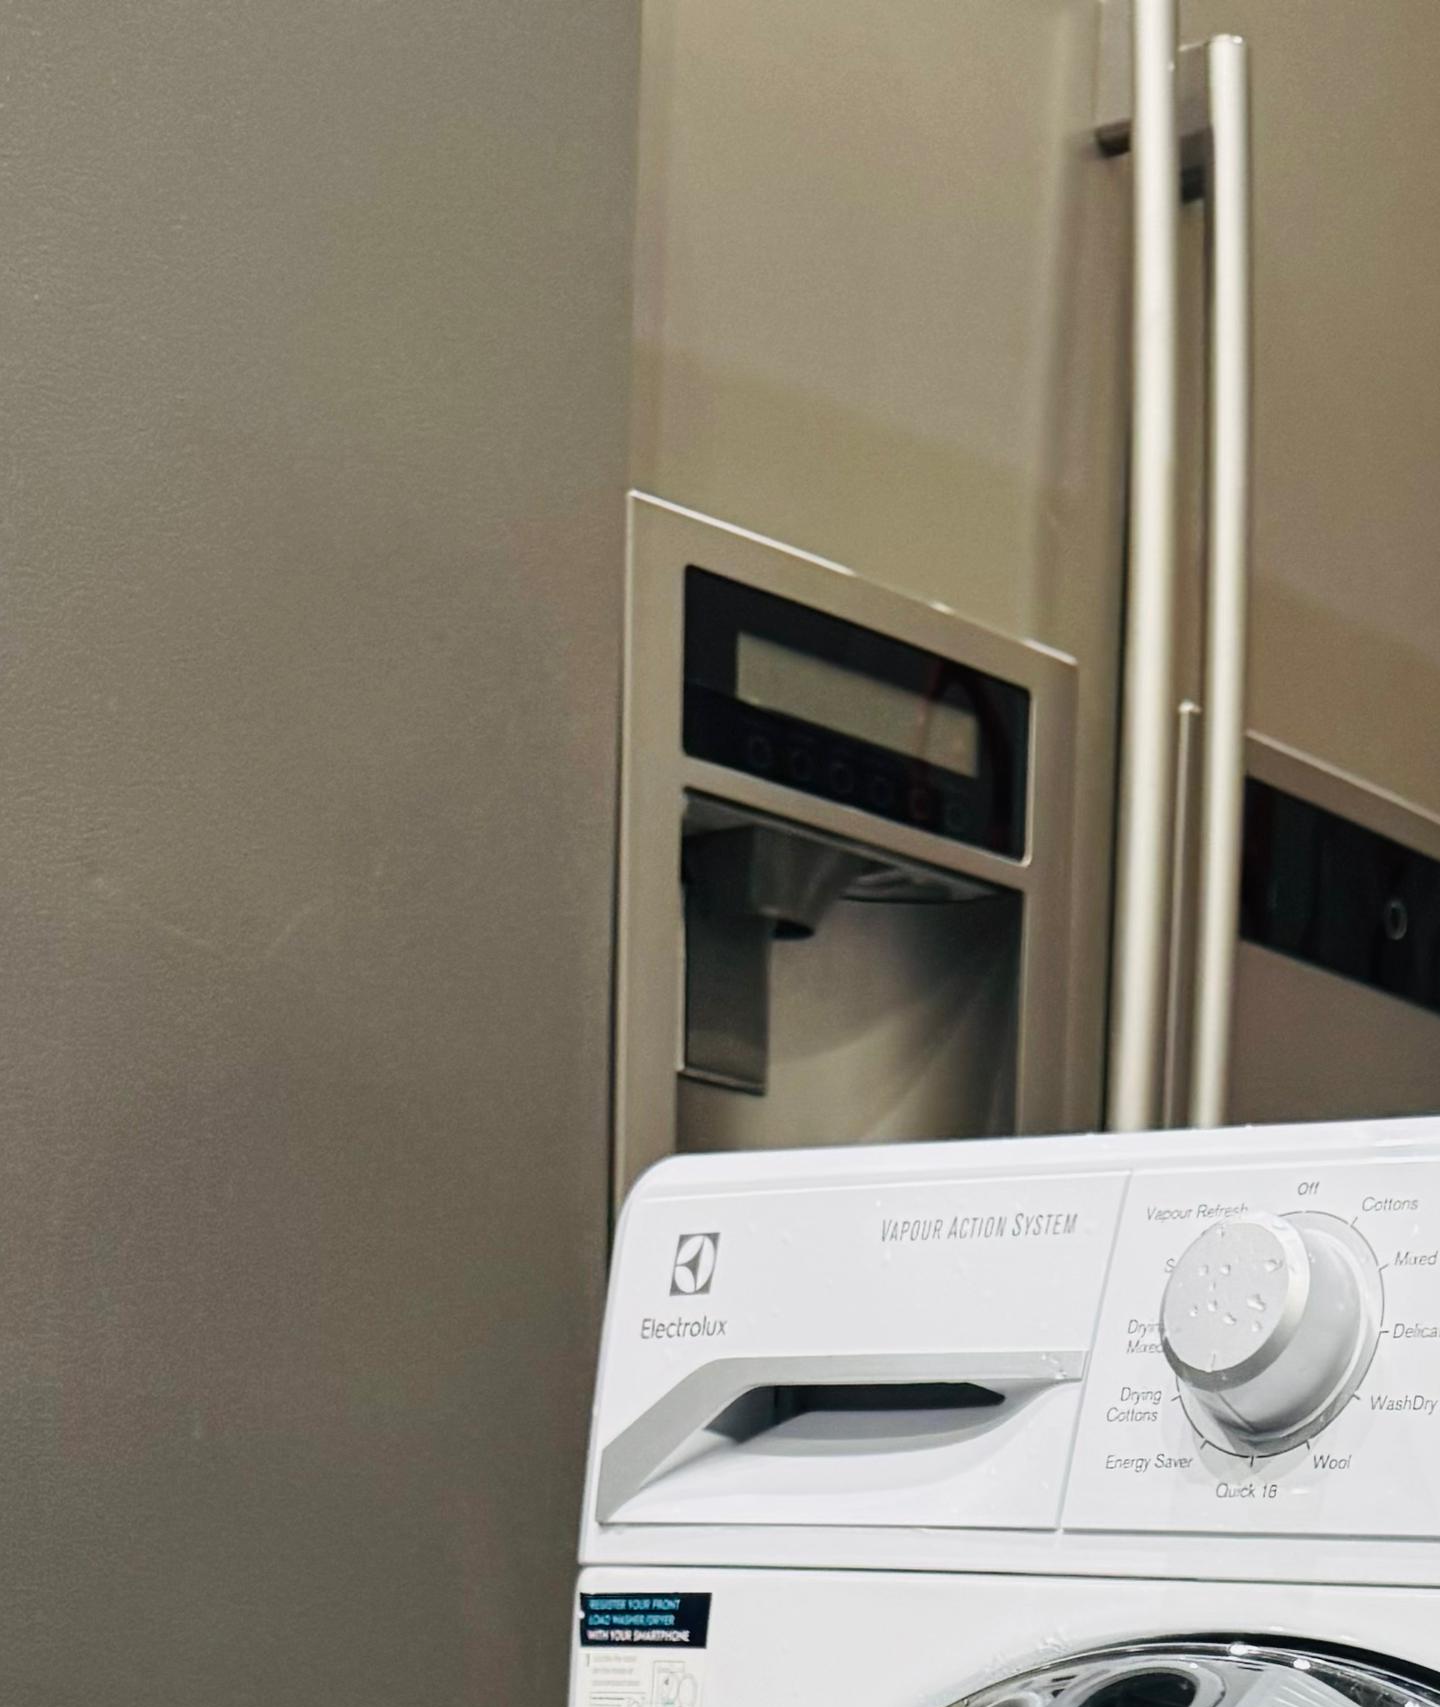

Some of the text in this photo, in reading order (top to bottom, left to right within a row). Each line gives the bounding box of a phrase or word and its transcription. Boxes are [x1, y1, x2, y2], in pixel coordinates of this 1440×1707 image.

[1298, 1182, 1320, 1196] Off
[1147, 1202, 1248, 1221] Vapour Refresh
[1362, 1196, 1419, 1212] Cottons
[882, 1212, 1079, 1242] VAPOUR ACTION SYSTEM
[1394, 1251, 1438, 1266] Mixed
[640, 1317, 727, 1340] Electrolux
[1120, 1386, 1162, 1405] Drying
[1370, 1395, 1438, 1415] WashDry
[1106, 1407, 1158, 1423] Cottons
[1106, 1454, 1193, 1472] Energy Saver
[1313, 1454, 1352, 1469] Wool
[1216, 1483, 1254, 1499] Quick
